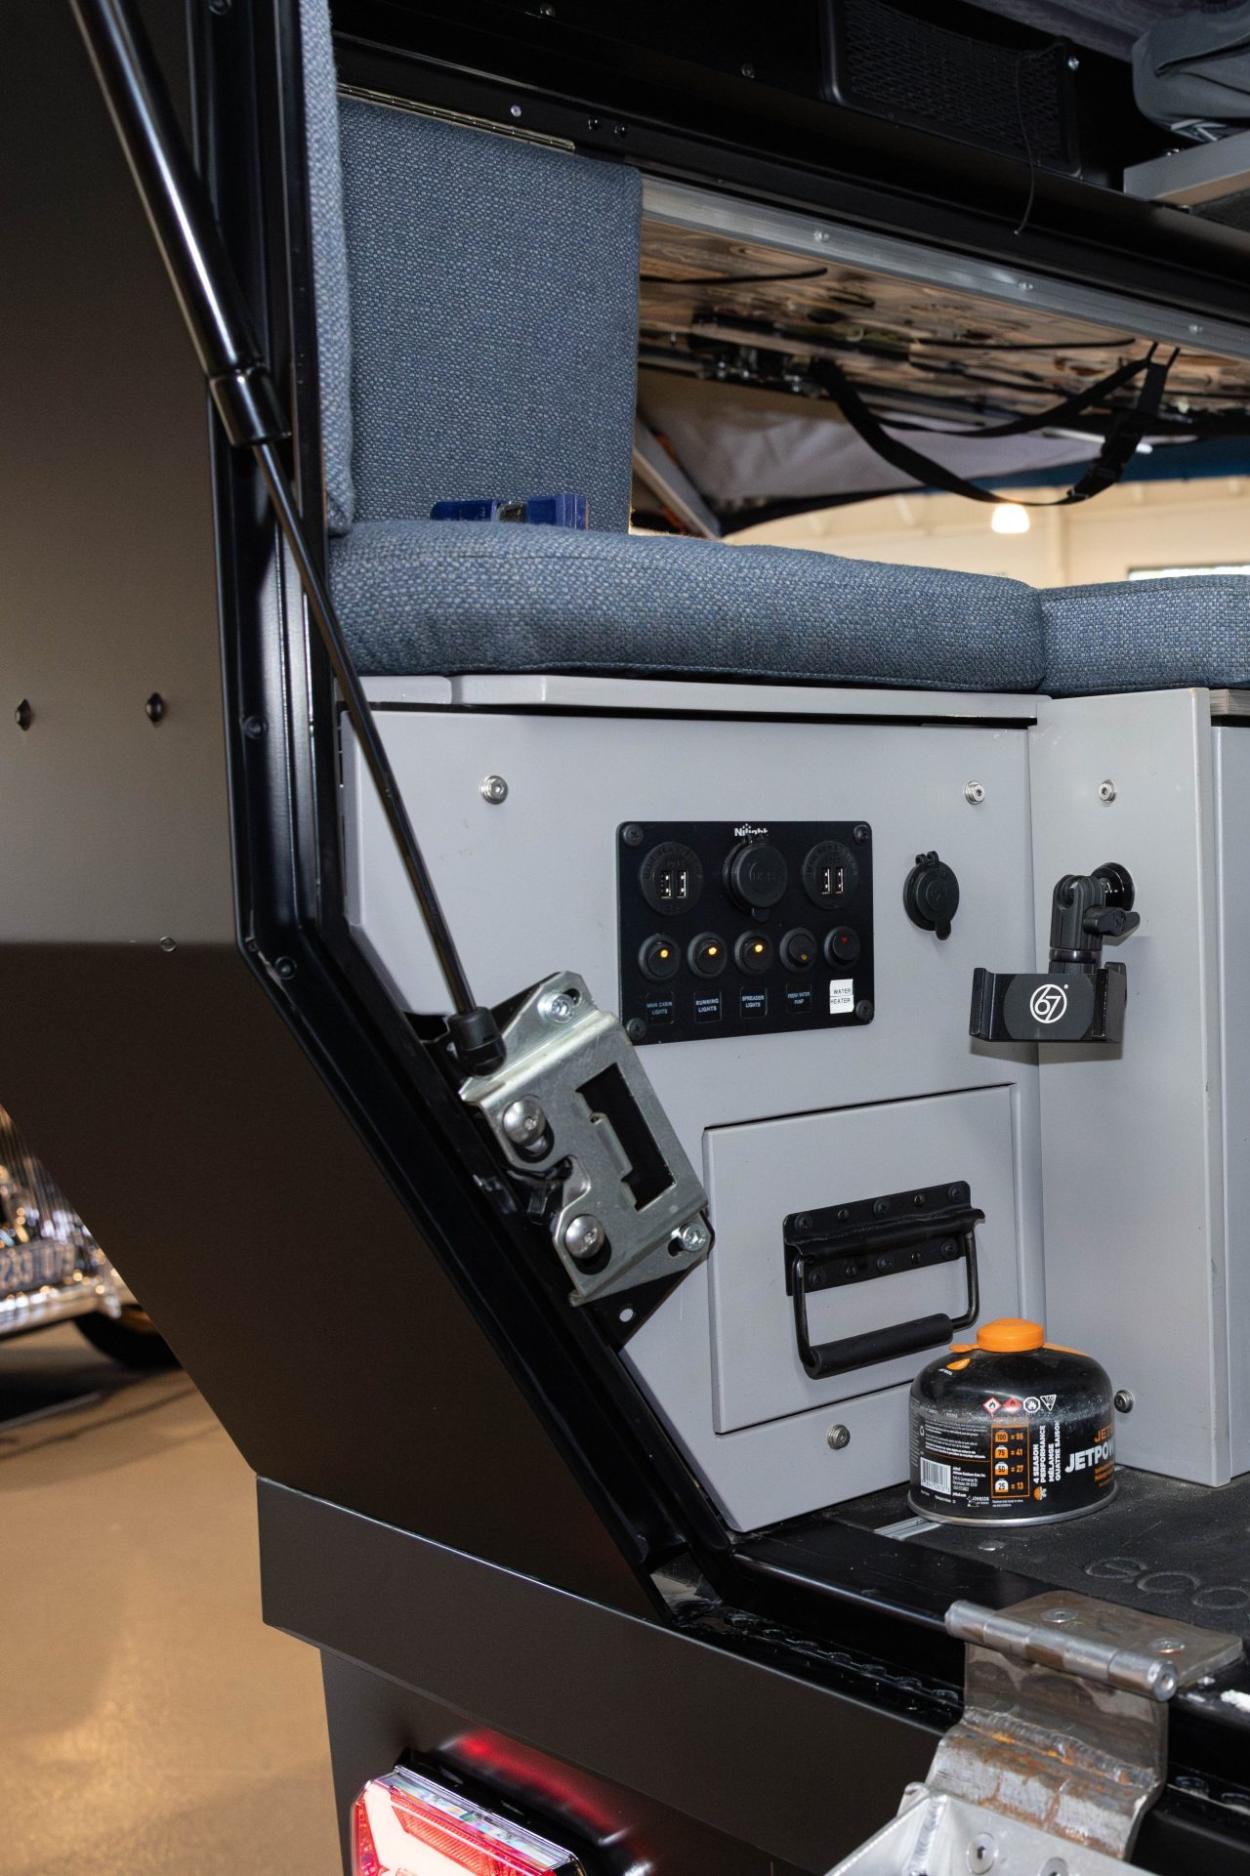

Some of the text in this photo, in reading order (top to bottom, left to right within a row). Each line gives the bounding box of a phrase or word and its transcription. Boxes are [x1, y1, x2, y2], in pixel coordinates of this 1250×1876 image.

[733, 823, 769, 837] Nilight
[695, 998, 720, 1006] RUNNING
[745, 1001, 761, 1009] LIGHTS
[830, 997, 851, 1005] HEATER
[651, 1008, 668, 1016] LIGHTS
[697, 1006, 718, 1014] LIGHTS
[1039, 1425, 1047, 1484] PERFORMANCE
[998, 1465, 1006, 1473] 50
[998, 1482, 1006, 1490] 25
